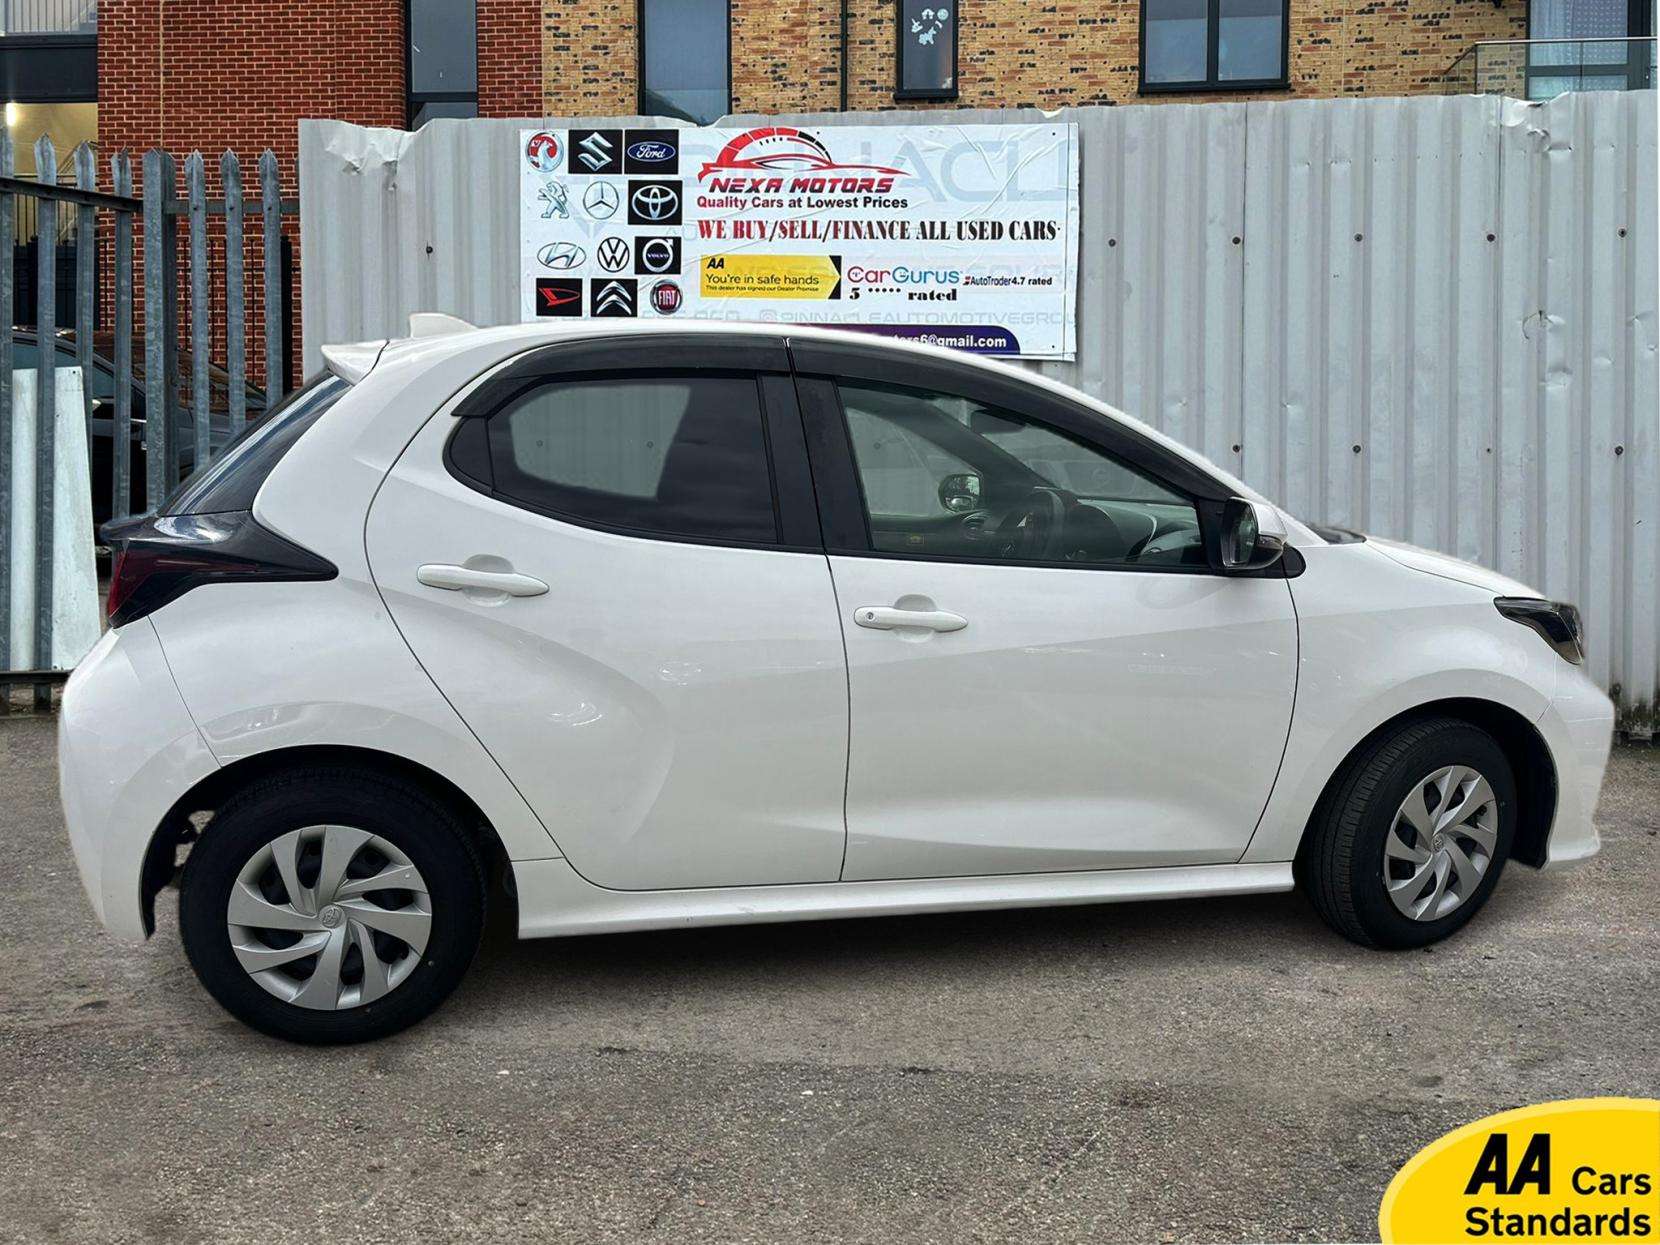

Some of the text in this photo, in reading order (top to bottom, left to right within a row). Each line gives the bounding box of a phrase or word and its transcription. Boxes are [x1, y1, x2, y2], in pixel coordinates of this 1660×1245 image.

[636, 144, 666, 159] Ford
[709, 177, 895, 194] NEXA MOTORS
[697, 196, 908, 210] Quality Cars at Lowest Prices
[697, 220, 727, 239] WE
[916, 220, 950, 240] ALL
[957, 220, 1003, 240] USED
[1009, 220, 1057, 240] CARS
[707, 257, 725, 269] AA
[706, 274, 819, 285] You're in safe hands
[847, 266, 960, 284] CarGurus
[1028, 277, 1052, 286] rated
[658, 290, 675, 305] FIAT
[849, 287, 957, 301] 5 rated
